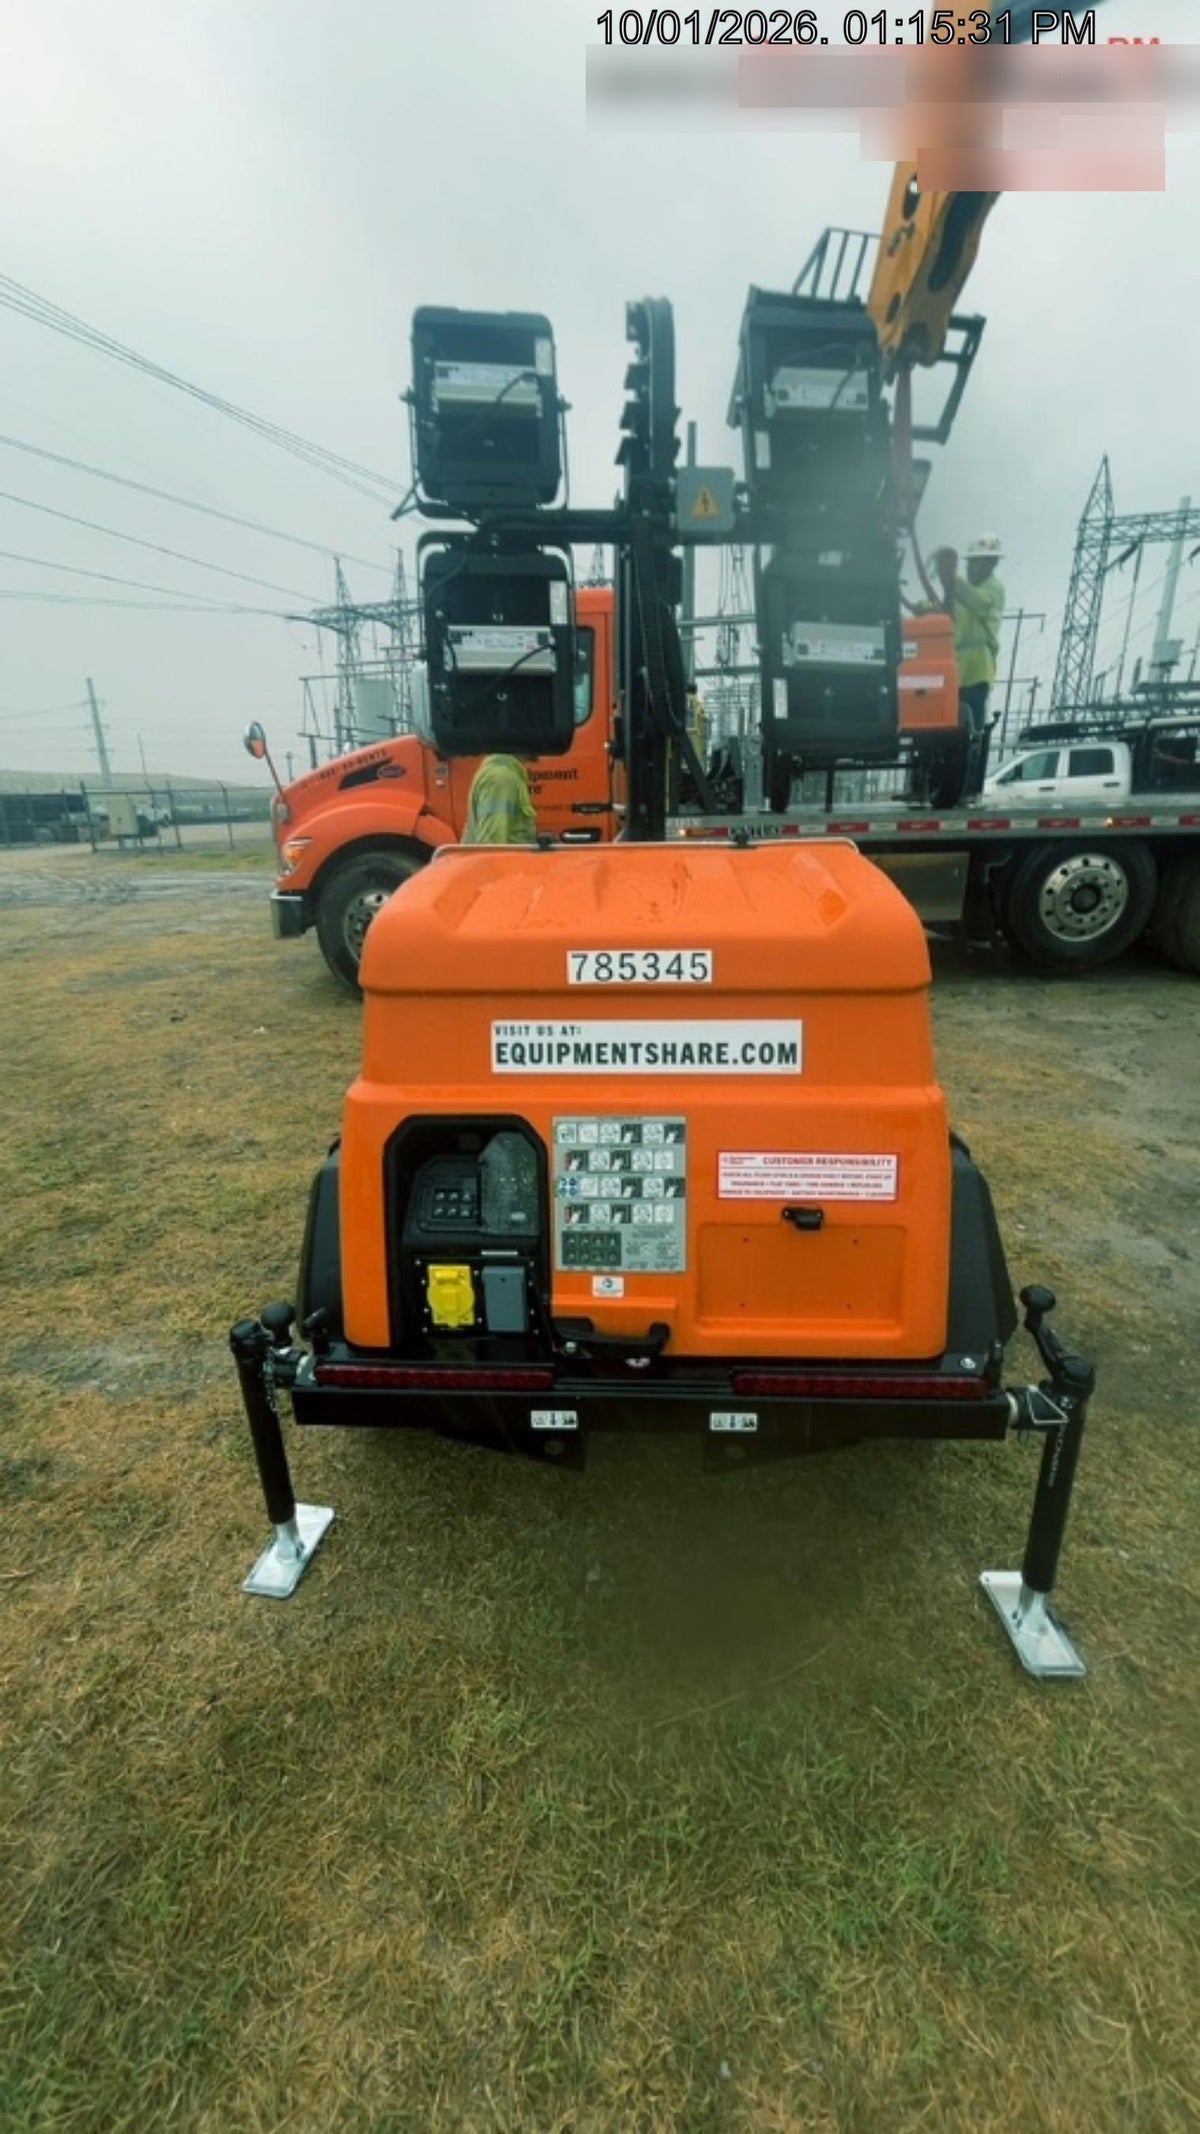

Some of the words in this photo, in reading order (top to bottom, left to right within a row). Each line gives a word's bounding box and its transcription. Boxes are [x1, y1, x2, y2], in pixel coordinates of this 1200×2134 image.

[571, 952, 708, 981] 785345
[495, 1025, 530, 1036] VISIT
[537, 1025, 554, 1036] US
[495, 1042, 798, 1066] EQUIPMENTSHARE.COM
[763, 1156, 814, 1165] CUSTOMER
[816, 1156, 892, 1166] RESPONSIBILITY
